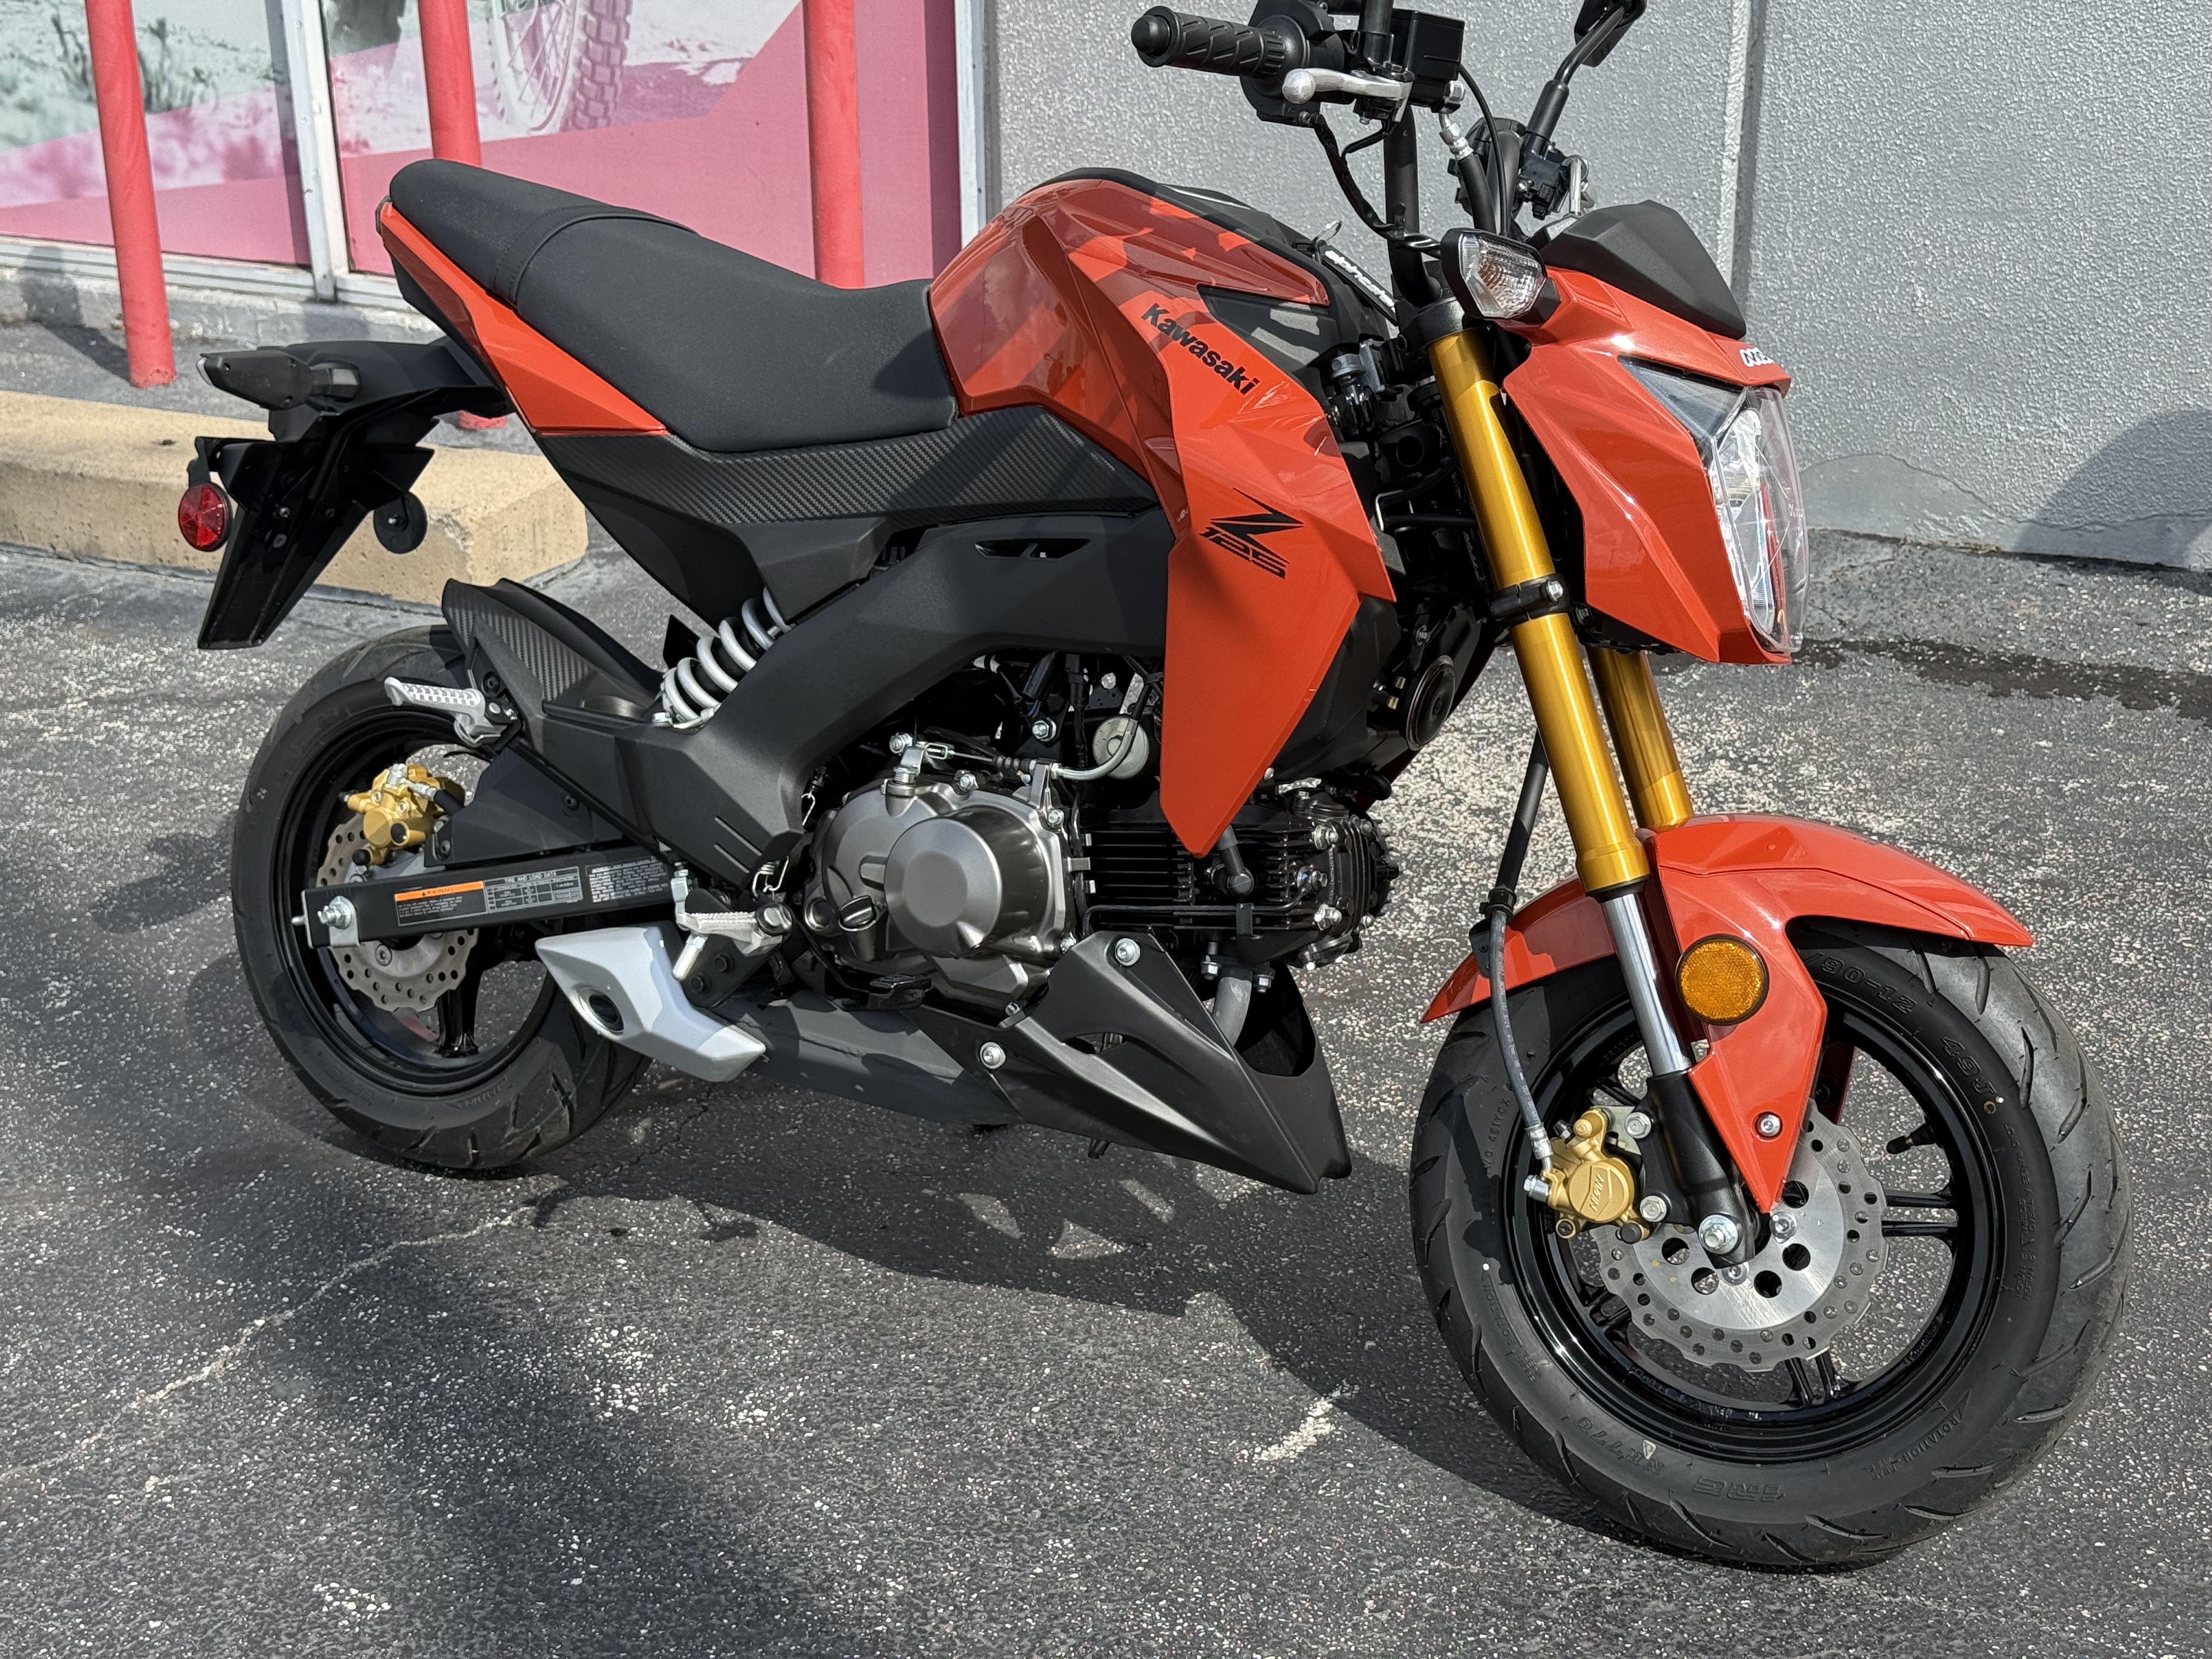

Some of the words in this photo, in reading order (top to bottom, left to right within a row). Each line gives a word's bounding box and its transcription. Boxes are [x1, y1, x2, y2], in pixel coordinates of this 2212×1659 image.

[1141, 303, 1261, 395] Kawasaki
[1482, 1285, 1516, 1346] ROTATION
[1901, 1414, 1962, 1463] ROTATION
